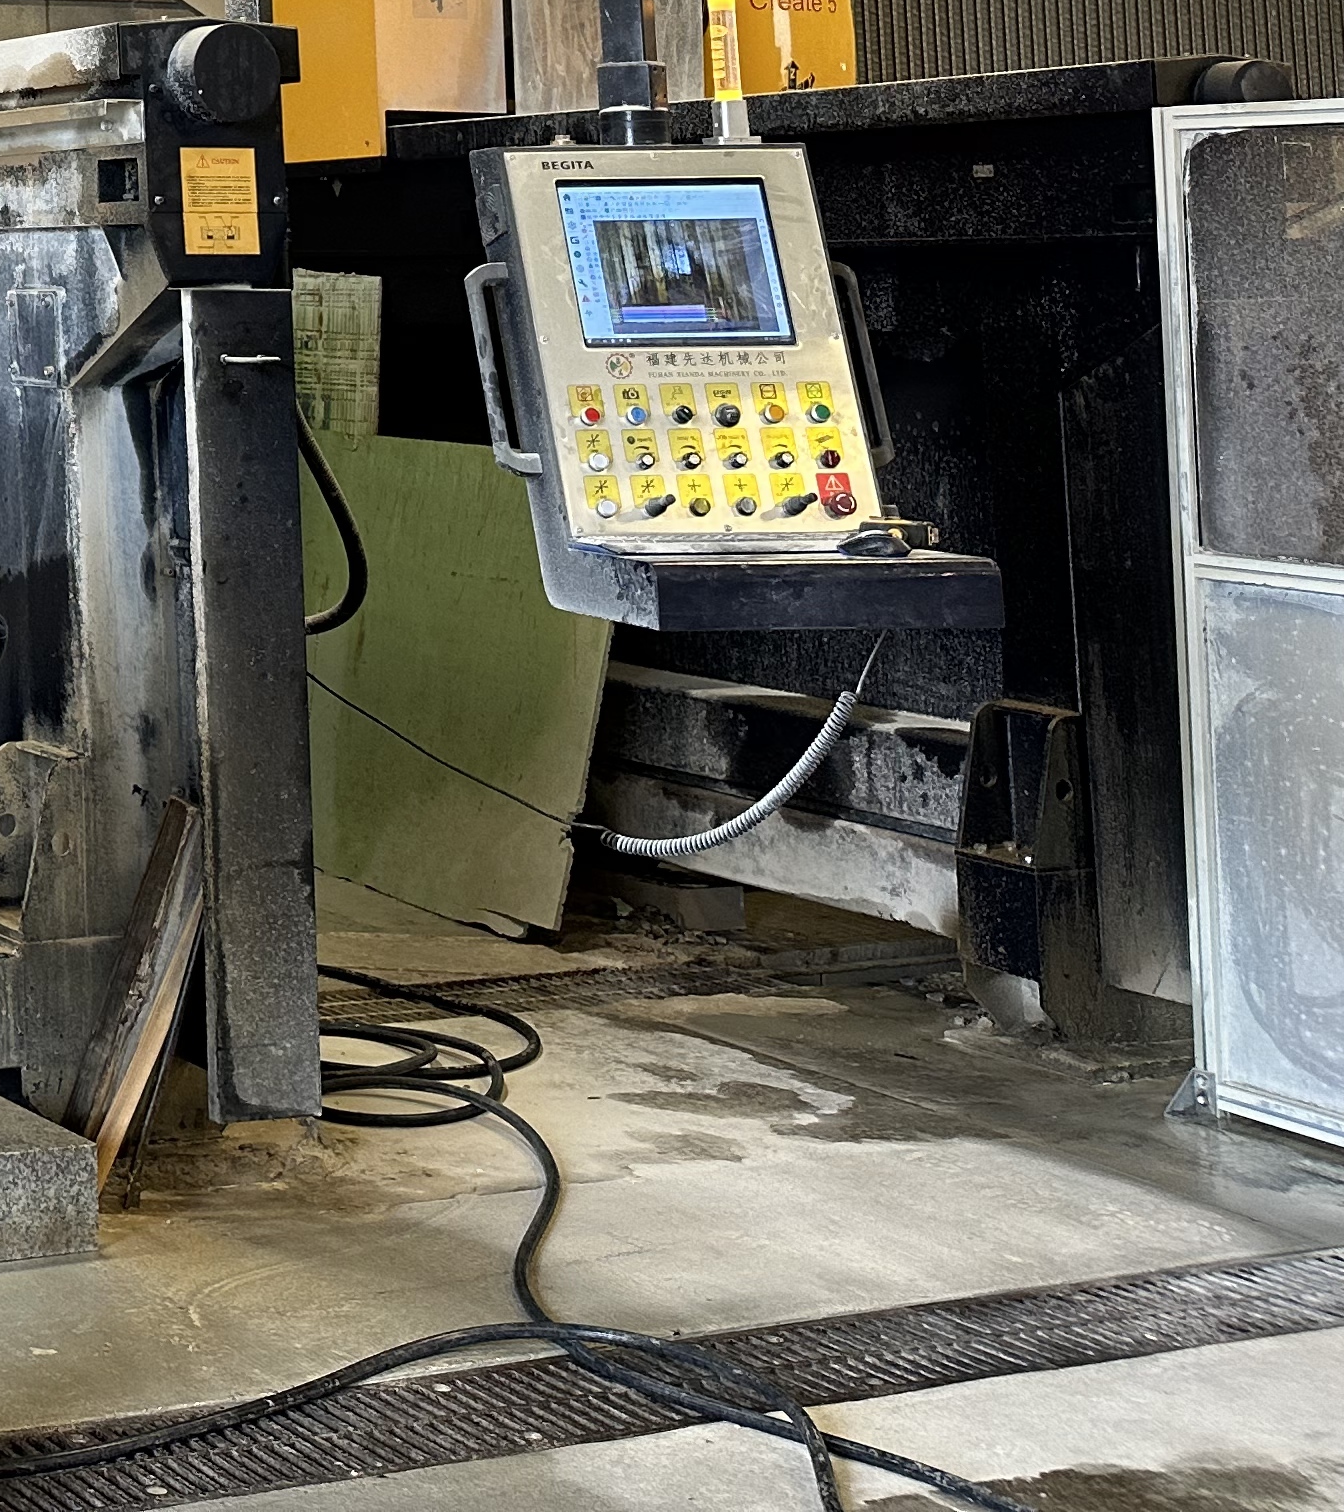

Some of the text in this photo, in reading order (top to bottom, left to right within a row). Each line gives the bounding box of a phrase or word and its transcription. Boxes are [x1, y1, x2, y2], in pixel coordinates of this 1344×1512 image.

[541, 160, 595, 170] BEGITA
[646, 351, 786, 366] 福建先达机械公司
